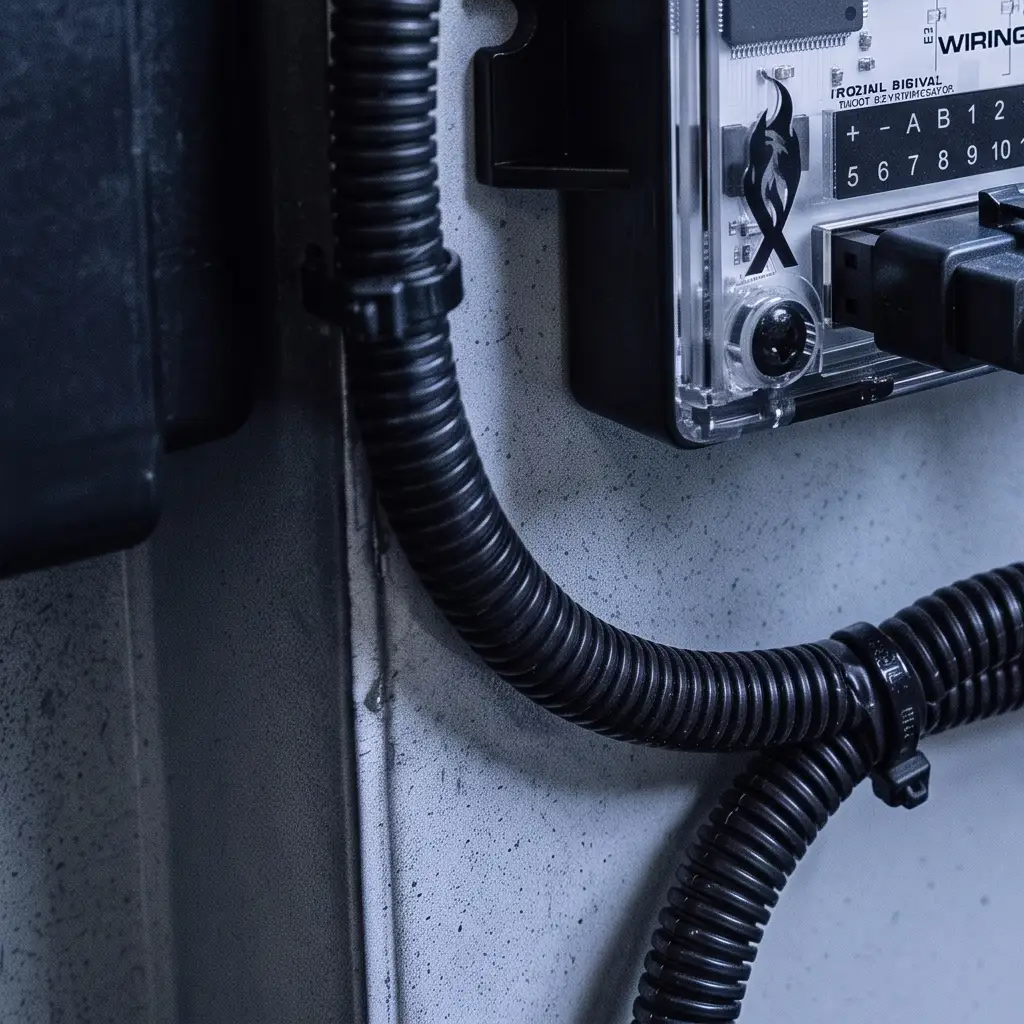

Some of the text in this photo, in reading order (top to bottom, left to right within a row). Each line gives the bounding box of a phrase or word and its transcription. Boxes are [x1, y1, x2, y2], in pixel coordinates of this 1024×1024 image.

[906, 113, 921, 134] A
[938, 108, 950, 128] B
[967, 104, 975, 124] 1
[994, 100, 1005, 121] 2
[847, 166, 859, 187] 5
[877, 161, 889, 182] 6
[907, 155, 919, 175] 7
[938, 150, 949, 170] 8
[966, 145, 978, 165] 9
[991, 139, 1011, 160] 10
